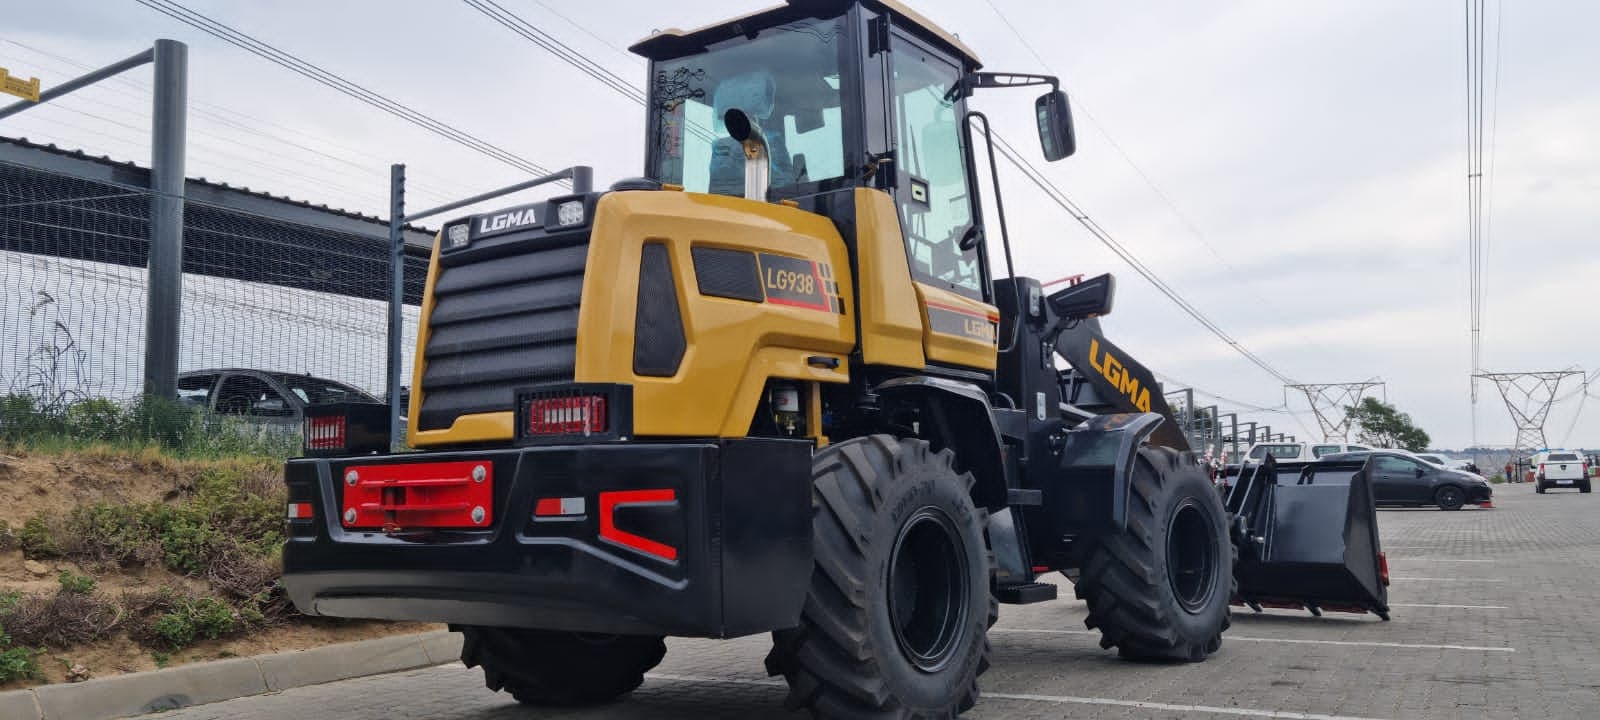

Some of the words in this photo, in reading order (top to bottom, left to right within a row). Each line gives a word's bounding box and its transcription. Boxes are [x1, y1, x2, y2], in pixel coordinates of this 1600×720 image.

[480, 208, 536, 234] LGMA
[767, 267, 814, 295] LG938
[1089, 338, 1151, 415] LGMA
